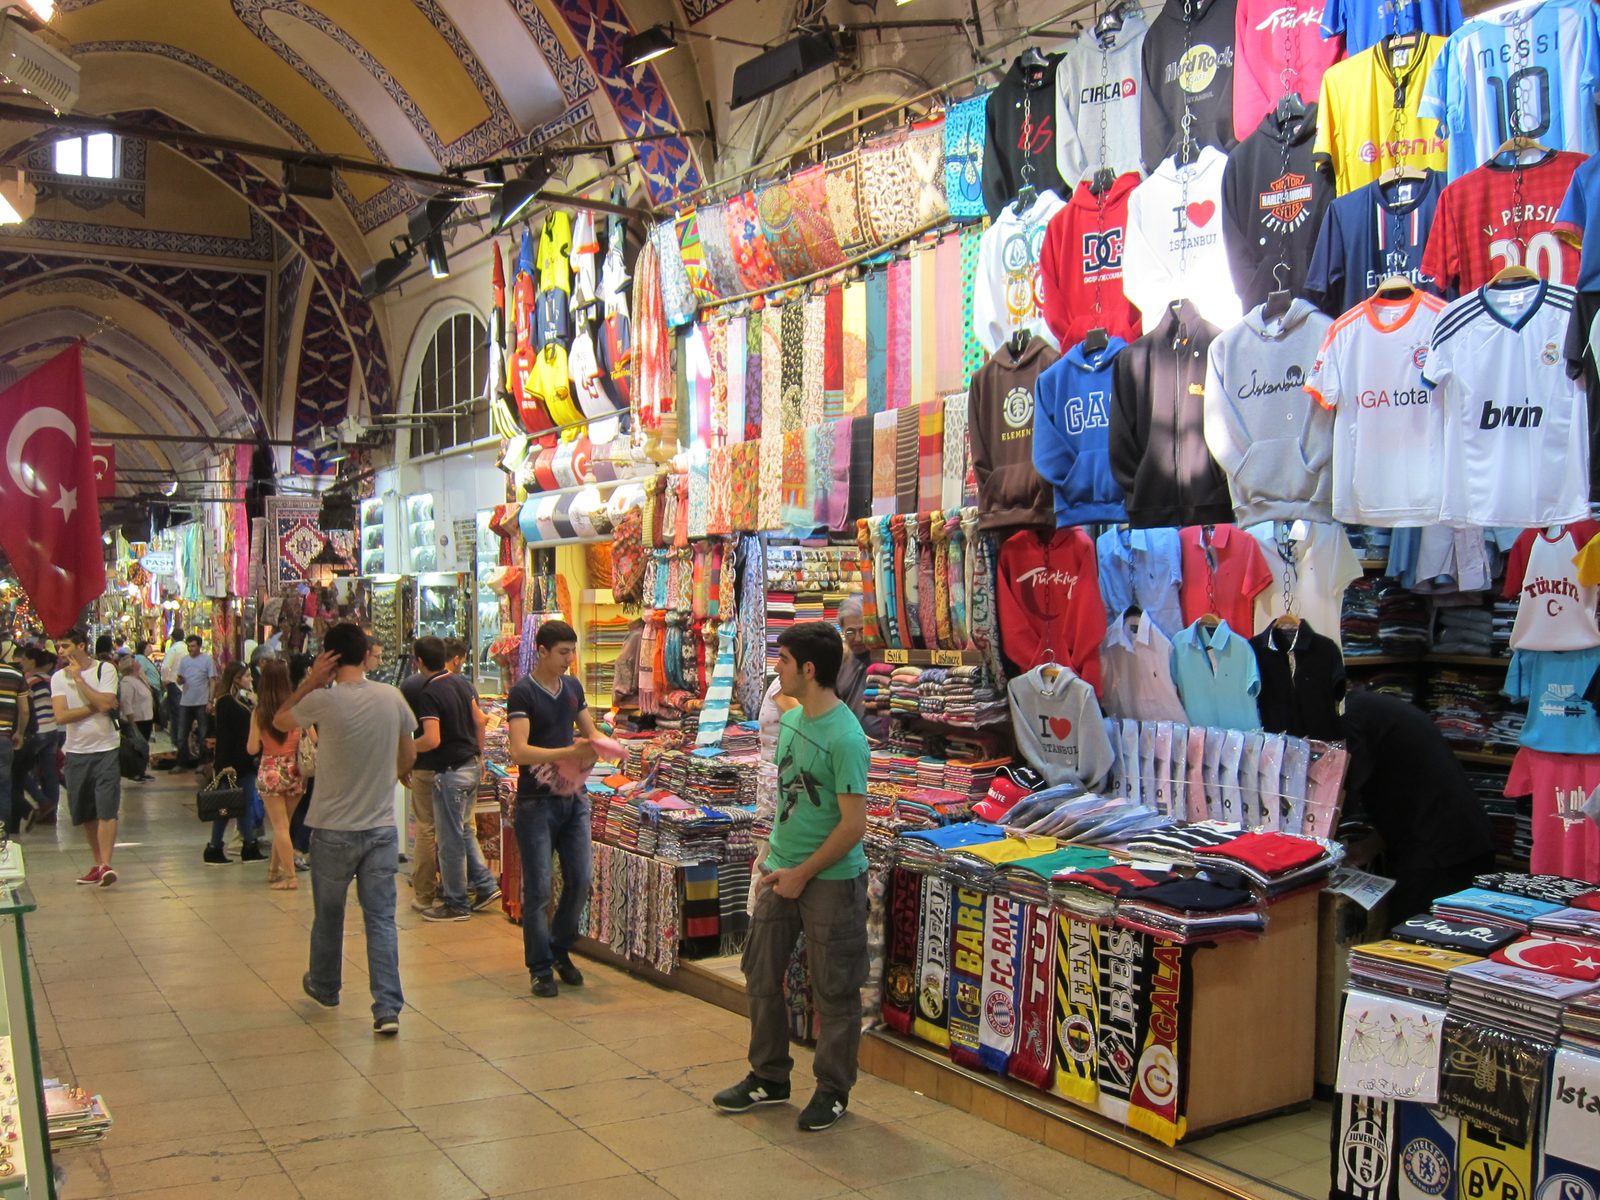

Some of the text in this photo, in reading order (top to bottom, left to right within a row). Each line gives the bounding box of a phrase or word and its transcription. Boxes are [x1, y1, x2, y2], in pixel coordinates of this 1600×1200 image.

[1165, 46, 1234, 84] Hard Rock
[1486, 66, 1551, 141] 10
[1172, 205, 1187, 233] I
[1386, 252, 1408, 268] Fly
[1064, 390, 1111, 435] GA
[1355, 389, 1391, 409] GA
[1479, 396, 1543, 430] bwin
[887, 650, 903, 662] Silk
[1039, 714, 1052, 738] I
[1040, 743, 1079, 755] STANBUL
[927, 879, 946, 969] REAL
[955, 887, 983, 977] BARC
[990, 958, 1014, 990] FC
[1108, 926, 1141, 1028] BEŞ
[1148, 936, 1182, 1042] GALA
[1348, 1131, 1386, 1153] JUVENTUS
[1407, 1140, 1445, 1166] CHELSEA
[1468, 1161, 1519, 1200] BVB
